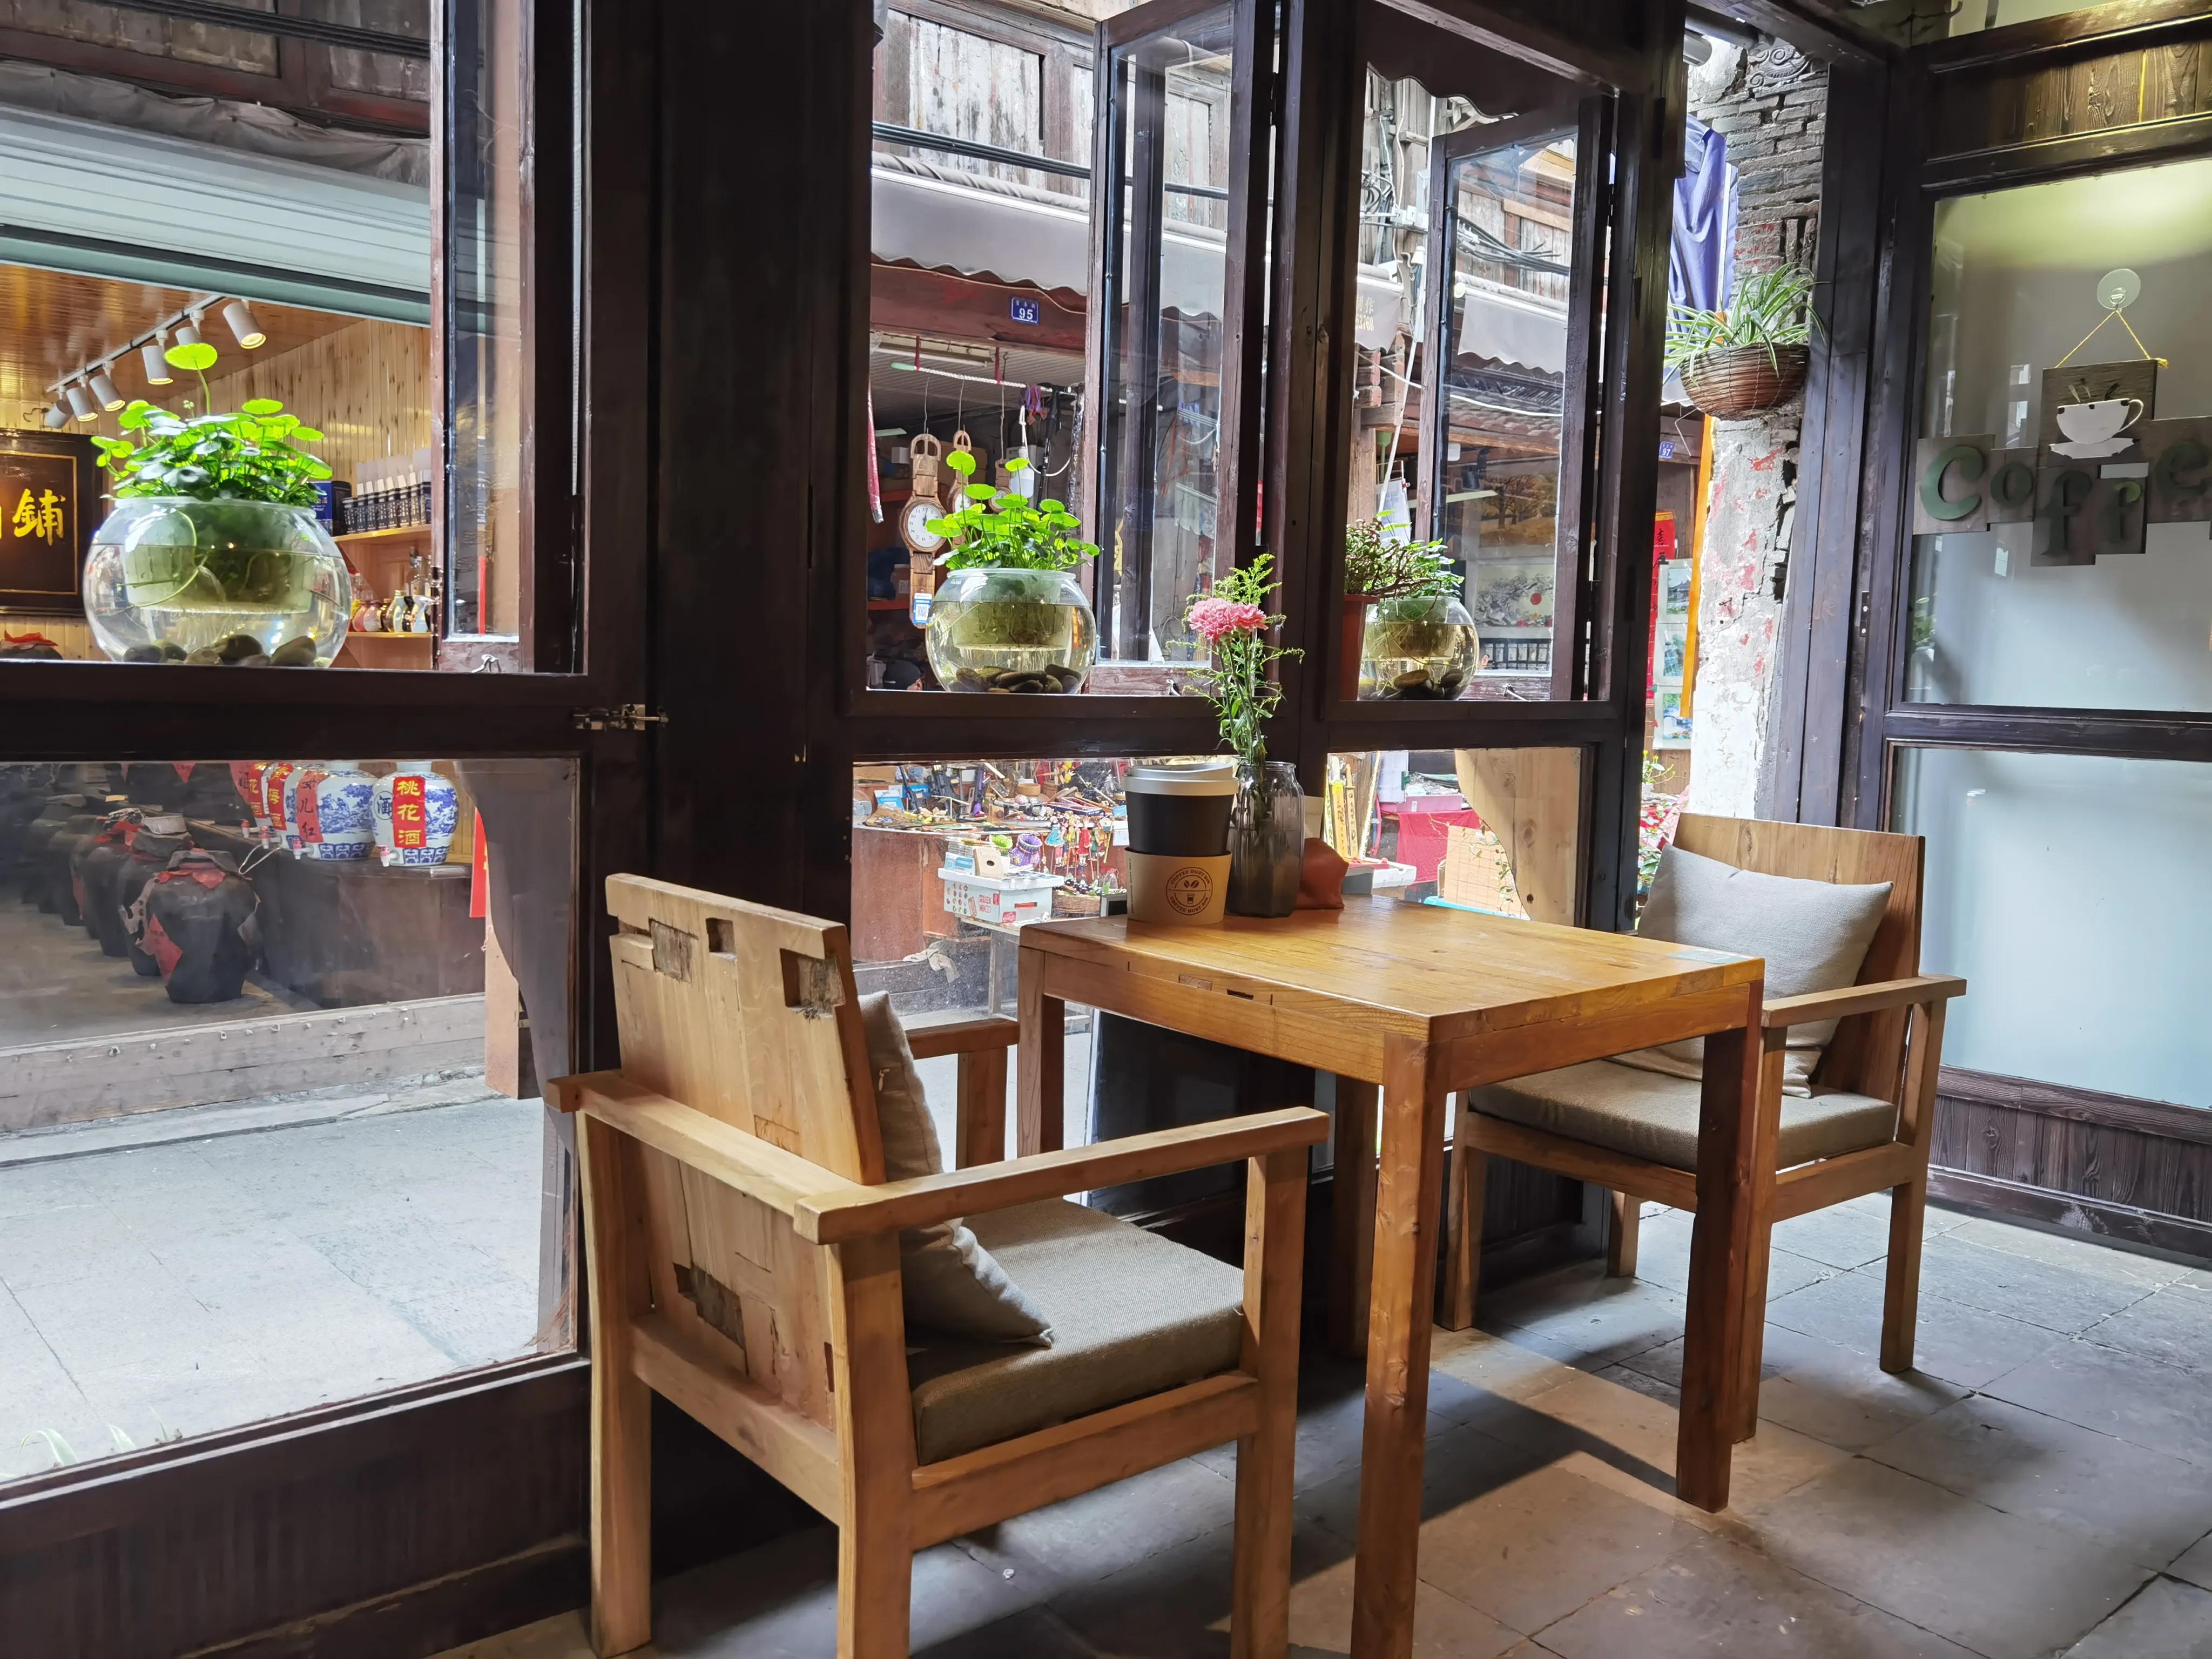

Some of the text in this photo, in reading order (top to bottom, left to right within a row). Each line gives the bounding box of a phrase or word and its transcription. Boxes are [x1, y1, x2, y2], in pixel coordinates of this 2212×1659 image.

[1019, 307, 1033, 320] 95
[1662, 448, 1671, 456] 97
[0, 488, 66, 546] 鋪
[249, 762, 268, 816] 花酒
[299, 779, 317, 838] 女儿红
[397, 780, 422, 845] 桃花酒
[1171, 870, 1189, 884] COFFEE
